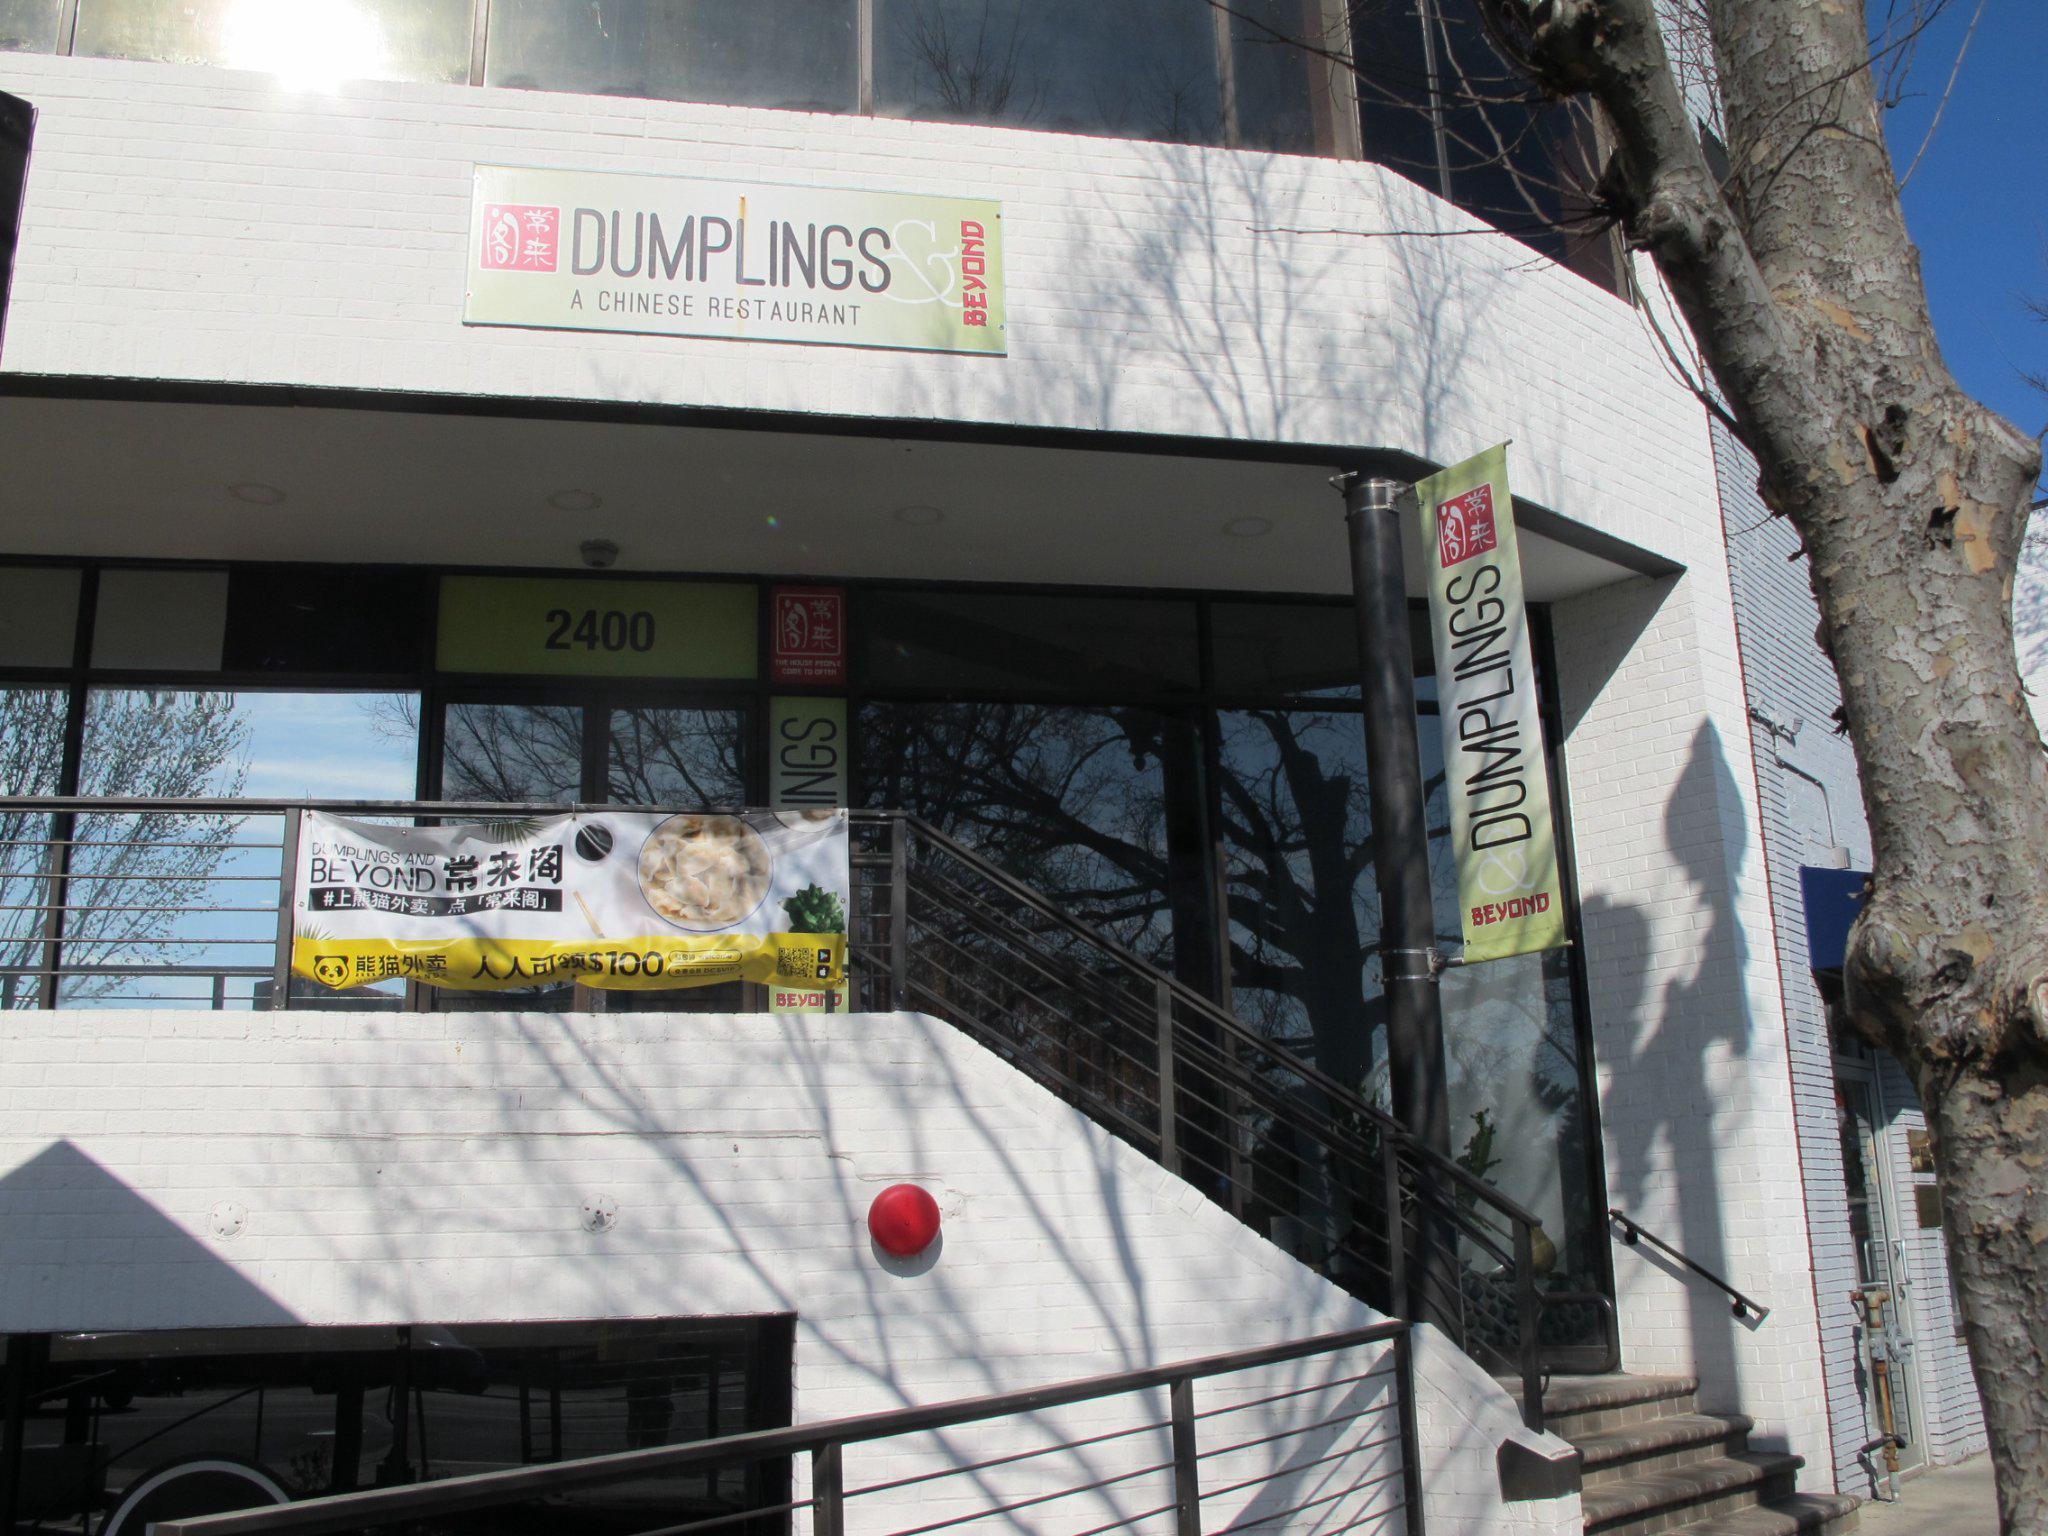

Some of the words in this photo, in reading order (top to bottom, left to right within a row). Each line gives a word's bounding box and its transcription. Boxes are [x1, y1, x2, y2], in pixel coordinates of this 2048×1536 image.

[571, 207, 891, 293] DUMPLINGS
[961, 220, 988, 327] BEYOND
[571, 292, 584, 310] A
[598, 294, 695, 317] CHINESE
[707, 299, 862, 327] RESTAURANT
[545, 608, 656, 652] 2400
[1445, 564, 1533, 852] DUMPLINGS
[779, 717, 839, 804] INGS
[310, 857, 437, 893] BEYOND
[311, 842, 400, 865] DUMPLINGS
[404, 853, 436, 866] AND
[442, 844, 564, 894] 常来阁
[1471, 892, 1550, 927] BEYOND
[355, 954, 448, 979] 熊猫外卖
